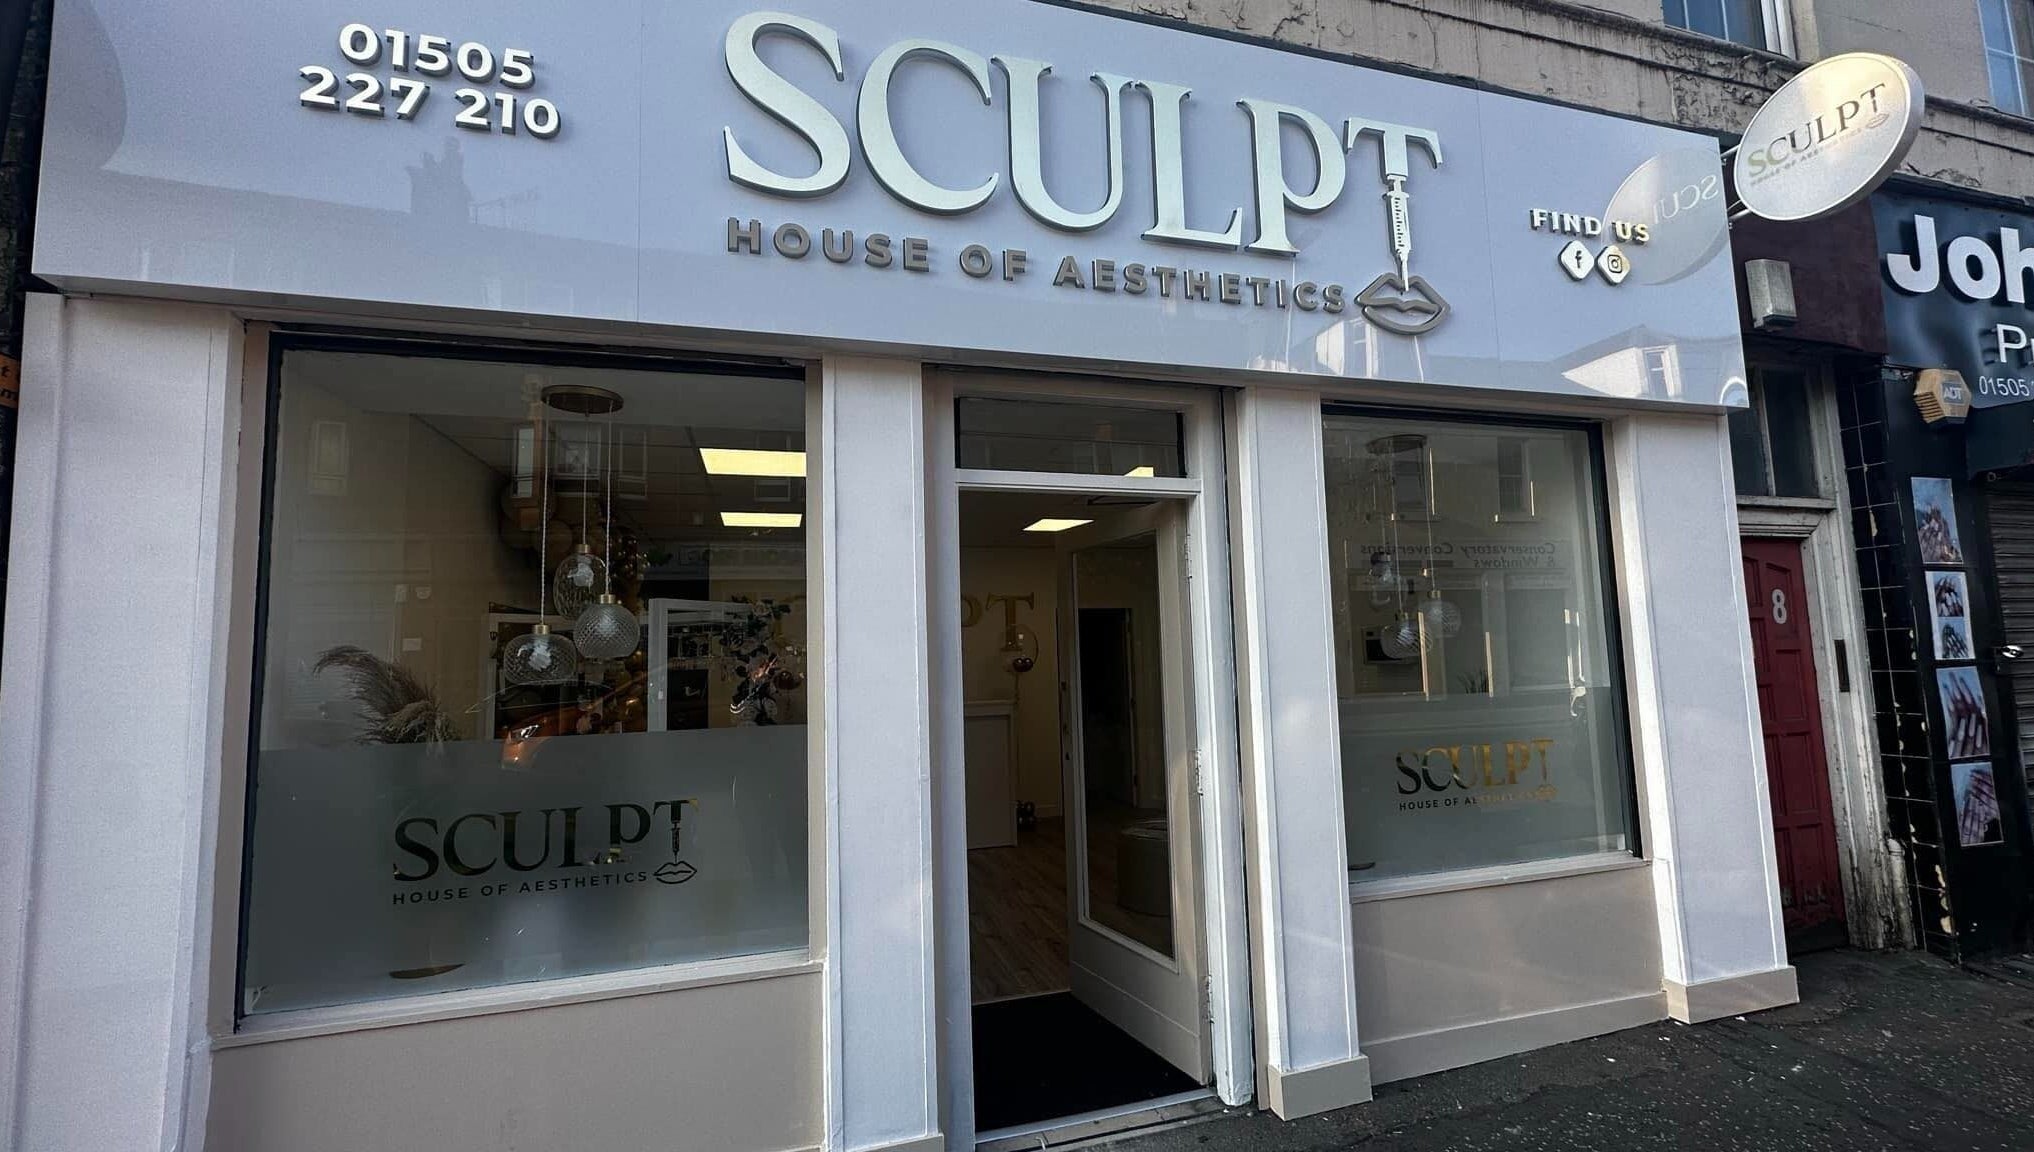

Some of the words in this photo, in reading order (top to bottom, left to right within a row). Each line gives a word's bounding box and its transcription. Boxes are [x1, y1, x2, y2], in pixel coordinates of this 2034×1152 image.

[338, 23, 536, 89] 01505
[298, 65, 430, 120] 227
[454, 87, 562, 139] 210
[724, 11, 1443, 291] SCULPT
[1747, 82, 1886, 178] SCULPT
[1529, 207, 1602, 237] FIND
[1612, 220, 1650, 245] US
[727, 216, 931, 273] HOUSE
[959, 244, 1028, 282] OF
[1053, 255, 1346, 315] AESTHETICS
[1996, 323, 2034, 363] P
[1943, 385, 1963, 401] ADT
[1979, 375, 2030, 397] 01505
[1771, 588, 1788, 624] 8
[1396, 737, 1554, 795] SCULPT
[1399, 799, 1438, 811] HOUSE
[1444, 797, 1459, 807] OF
[393, 798, 699, 882] SCULPT
[392, 887, 468, 905] HOUSE
[480, 883, 508, 898] OF
[519, 870, 648, 893] AESTHETICS
